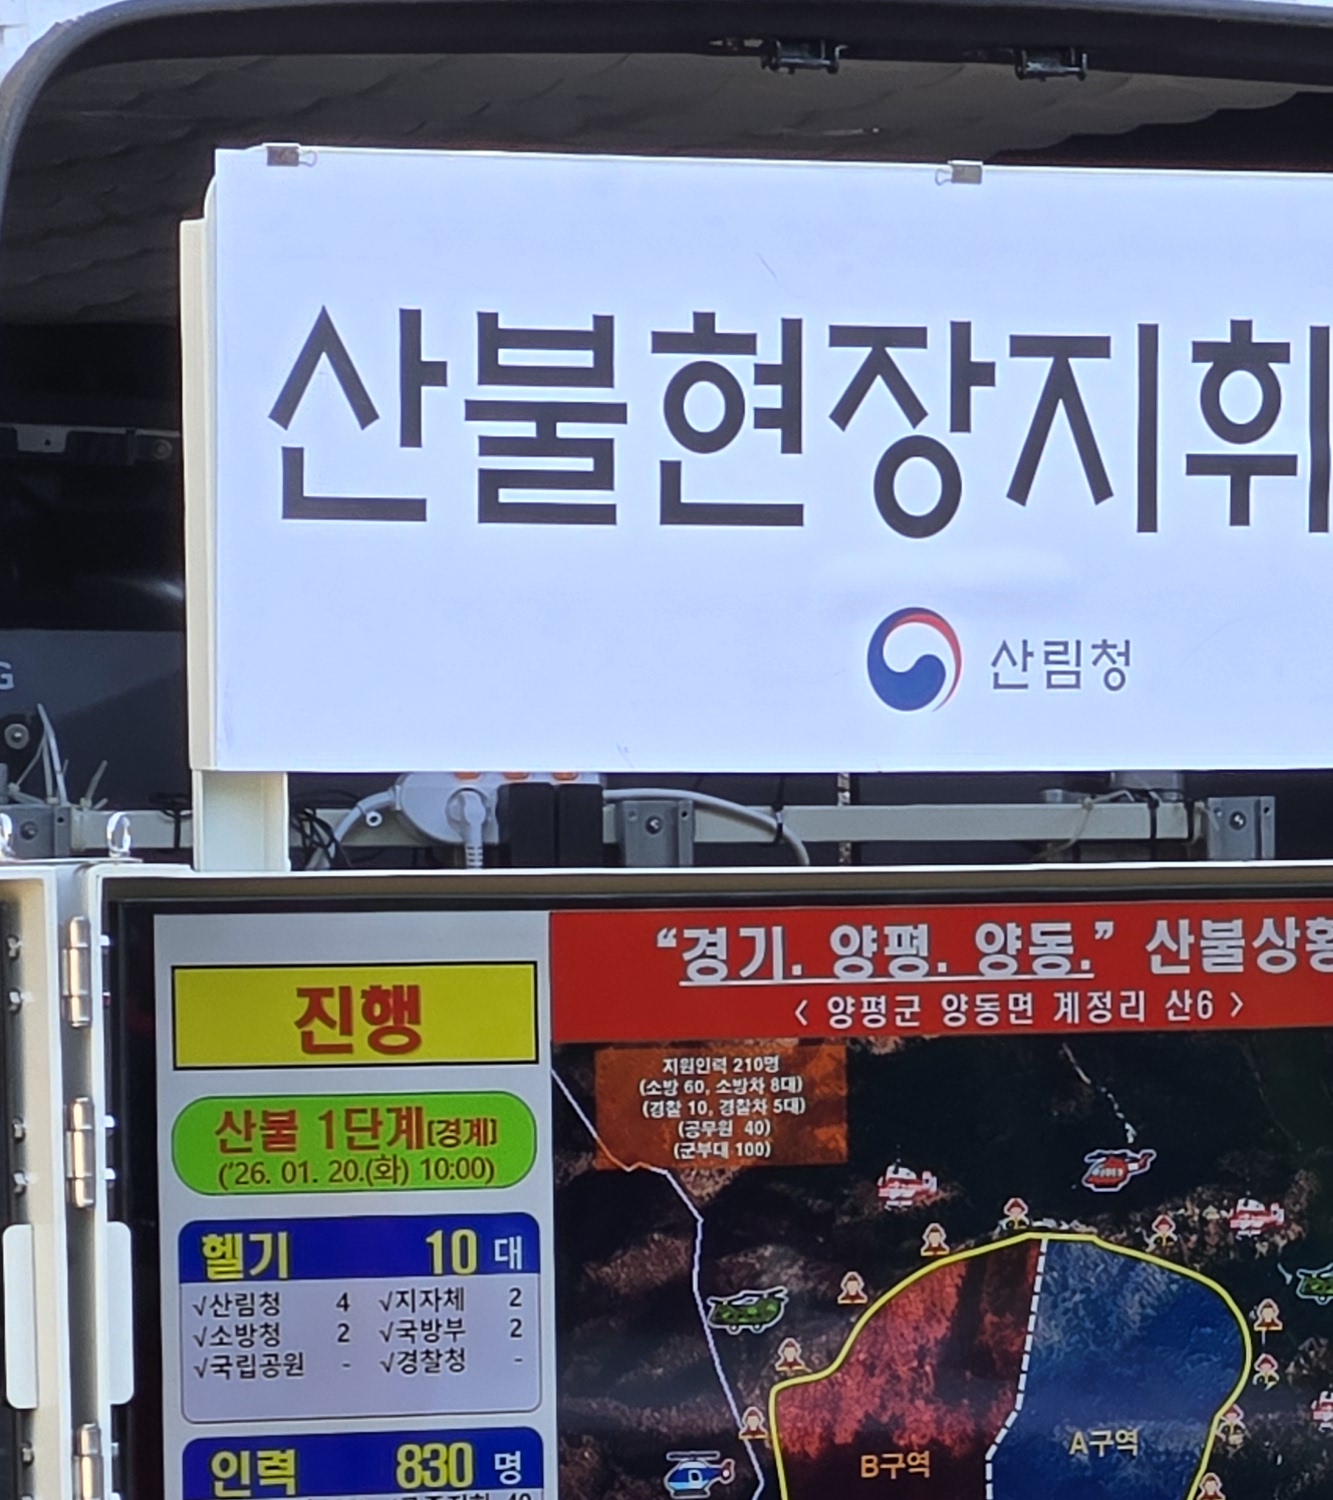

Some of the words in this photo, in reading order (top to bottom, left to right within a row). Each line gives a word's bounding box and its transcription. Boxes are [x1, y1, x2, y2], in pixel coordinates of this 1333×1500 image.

[989, 637, 1134, 696] 산림청
[829, 921, 948, 980] 양평.
[294, 984, 423, 1055] 진행
[826, 994, 921, 1030] 양평군
[941, 991, 1034, 1027] 양동면
[1053, 989, 1146, 1024] 계정리
[1165, 988, 1214, 1022] 산6
[662, 1057, 727, 1075] 지원인력
[733, 1055, 780, 1073] 210명
[639, 1079, 678, 1097] (소방
[684, 1081, 710, 1097] 60,
[715, 1077, 765, 1096] 소방차
[770, 1076, 803, 1093] 8대)
[642, 1101, 682, 1118] (경찰
[687, 1102, 713, 1118] 10,
[719, 1098, 768, 1117] 경찰차
[773, 1097, 807, 1115] 5대)
[214, 1109, 298, 1154] 산불
[678, 1120, 733, 1139] (공무원
[743, 1119, 771, 1137] 40)
[673, 1142, 729, 1160] (군부대
[735, 1141, 772, 1158] 100)
[281, 1162, 319, 1185] 01.
[328, 1155, 410, 1187] 20.(화)
[422, 1156, 496, 1185] 10:00)
[201, 1231, 290, 1281] 헬기
[425, 1229, 478, 1275] 10
[494, 1235, 523, 1270] 대
[335, 1292, 351, 1313] 4
[508, 1288, 522, 1308] 2
[337, 1323, 351, 1343] 2
[509, 1319, 523, 1338] 2
[1069, 1428, 1139, 1457] A구역
[210, 1448, 297, 1497] 인력
[396, 1442, 474, 1489] 830
[494, 1451, 522, 1485] 명
[861, 1451, 930, 1479] B구역
